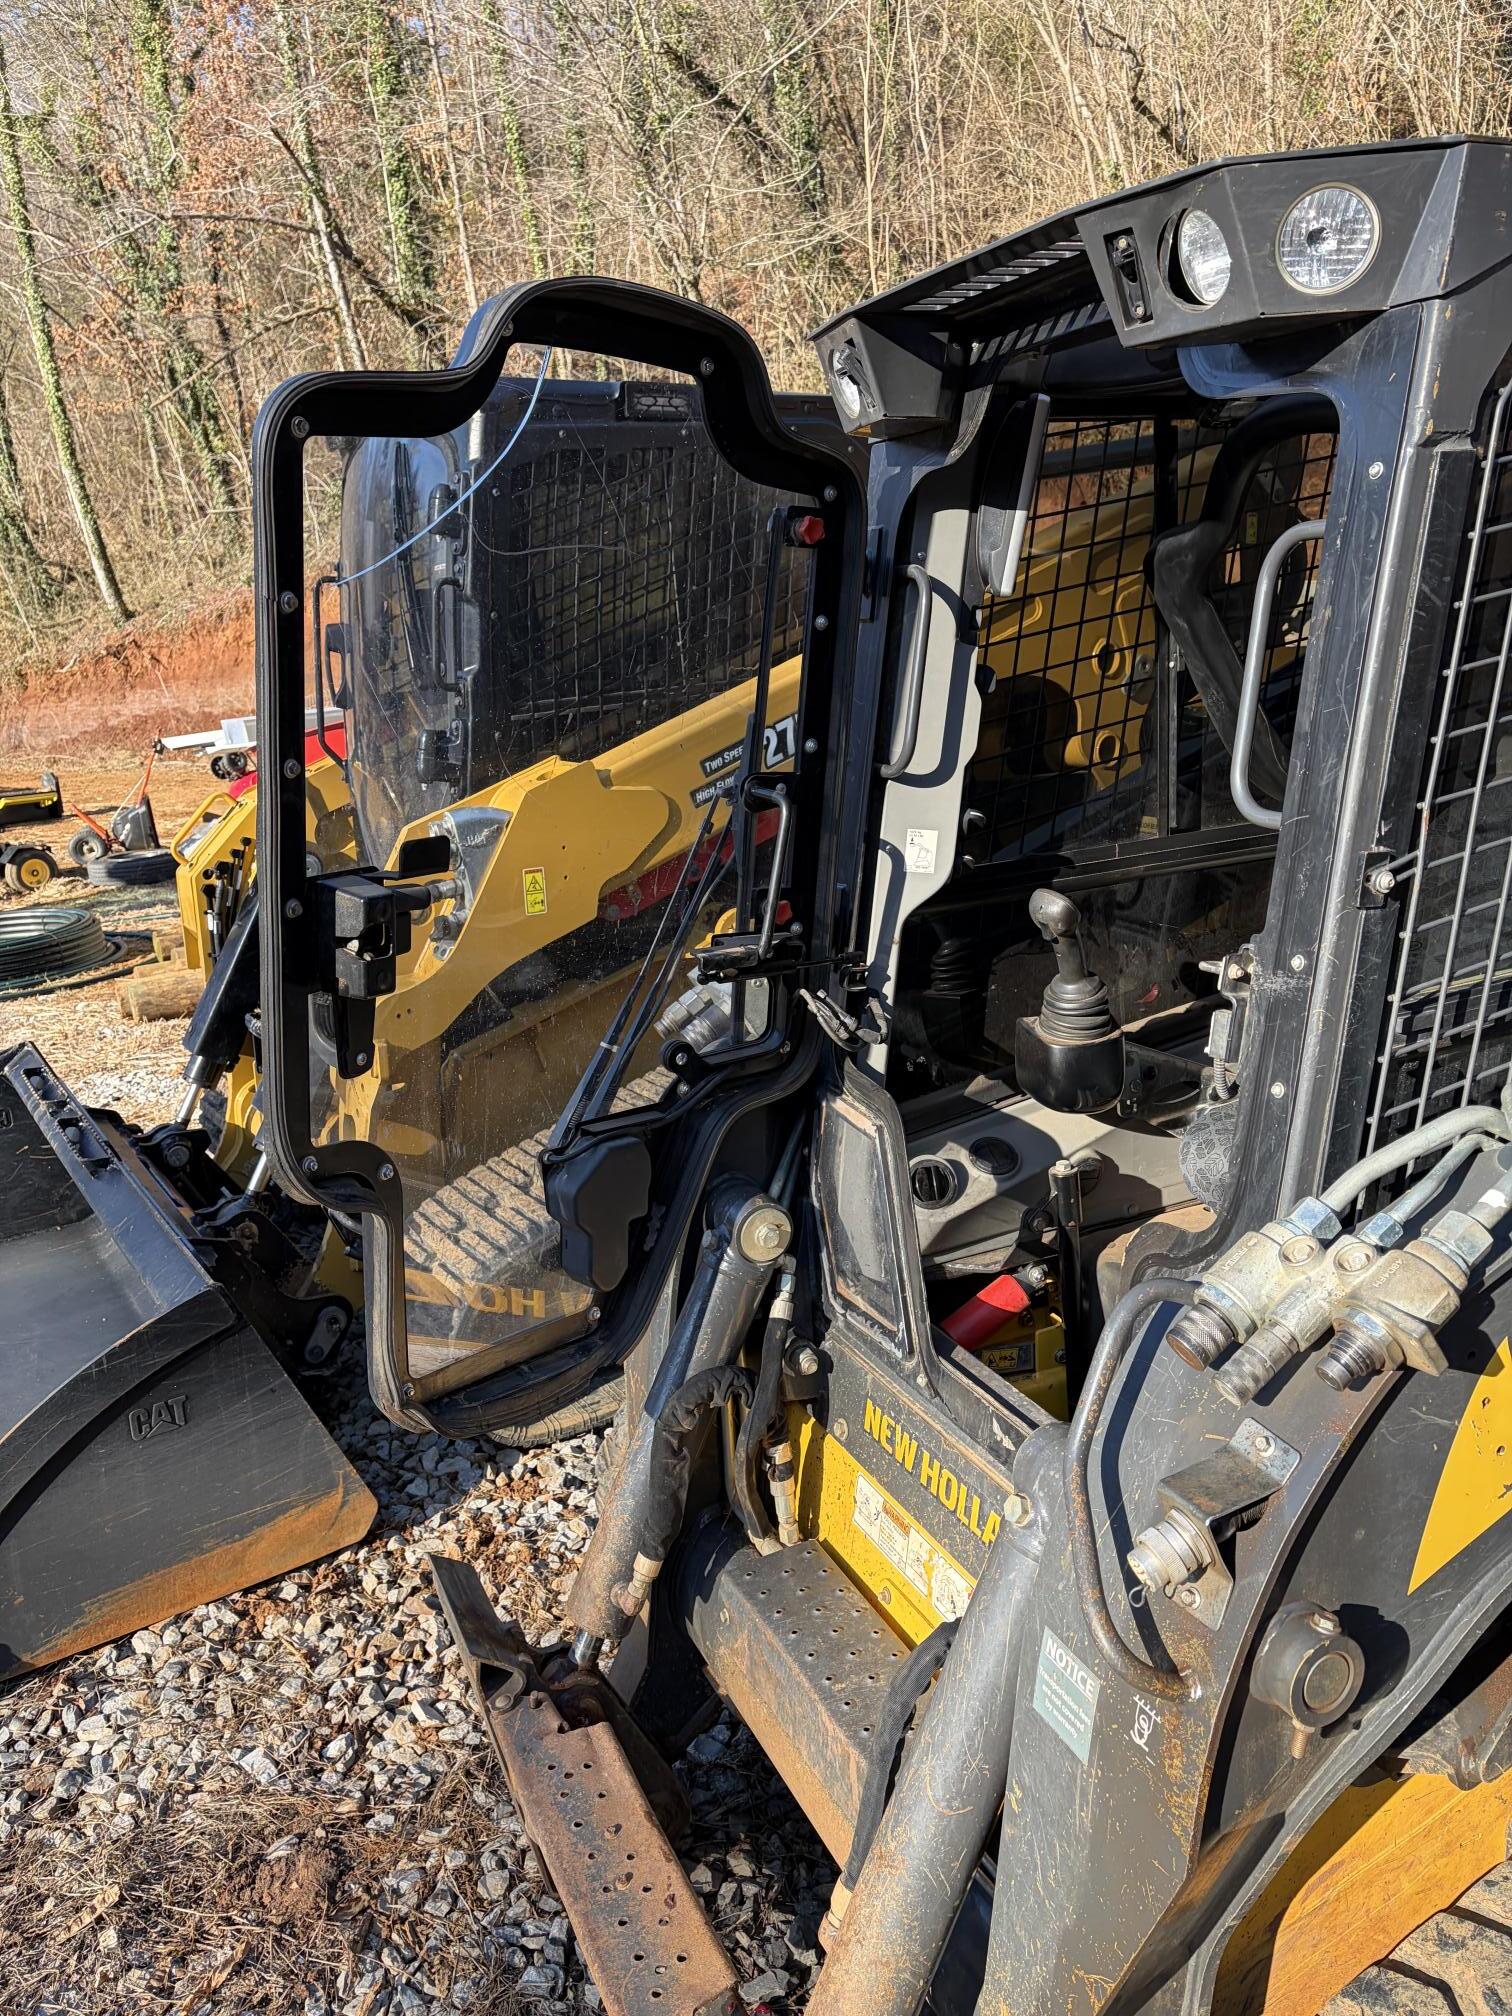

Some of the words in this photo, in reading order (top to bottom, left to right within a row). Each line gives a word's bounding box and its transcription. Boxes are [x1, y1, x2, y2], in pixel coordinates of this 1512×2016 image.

[723, 745, 743, 764] SPEE
[764, 714, 798, 767] 27
[128, 1394, 187, 1441] CAT
[864, 1398, 918, 1473] NEW
[920, 1450, 1001, 1545] HOLLA
[1046, 1635, 1094, 1698] NOTICE
[1052, 1707, 1078, 1739] warranty
[1061, 1704, 1084, 1732] covered
